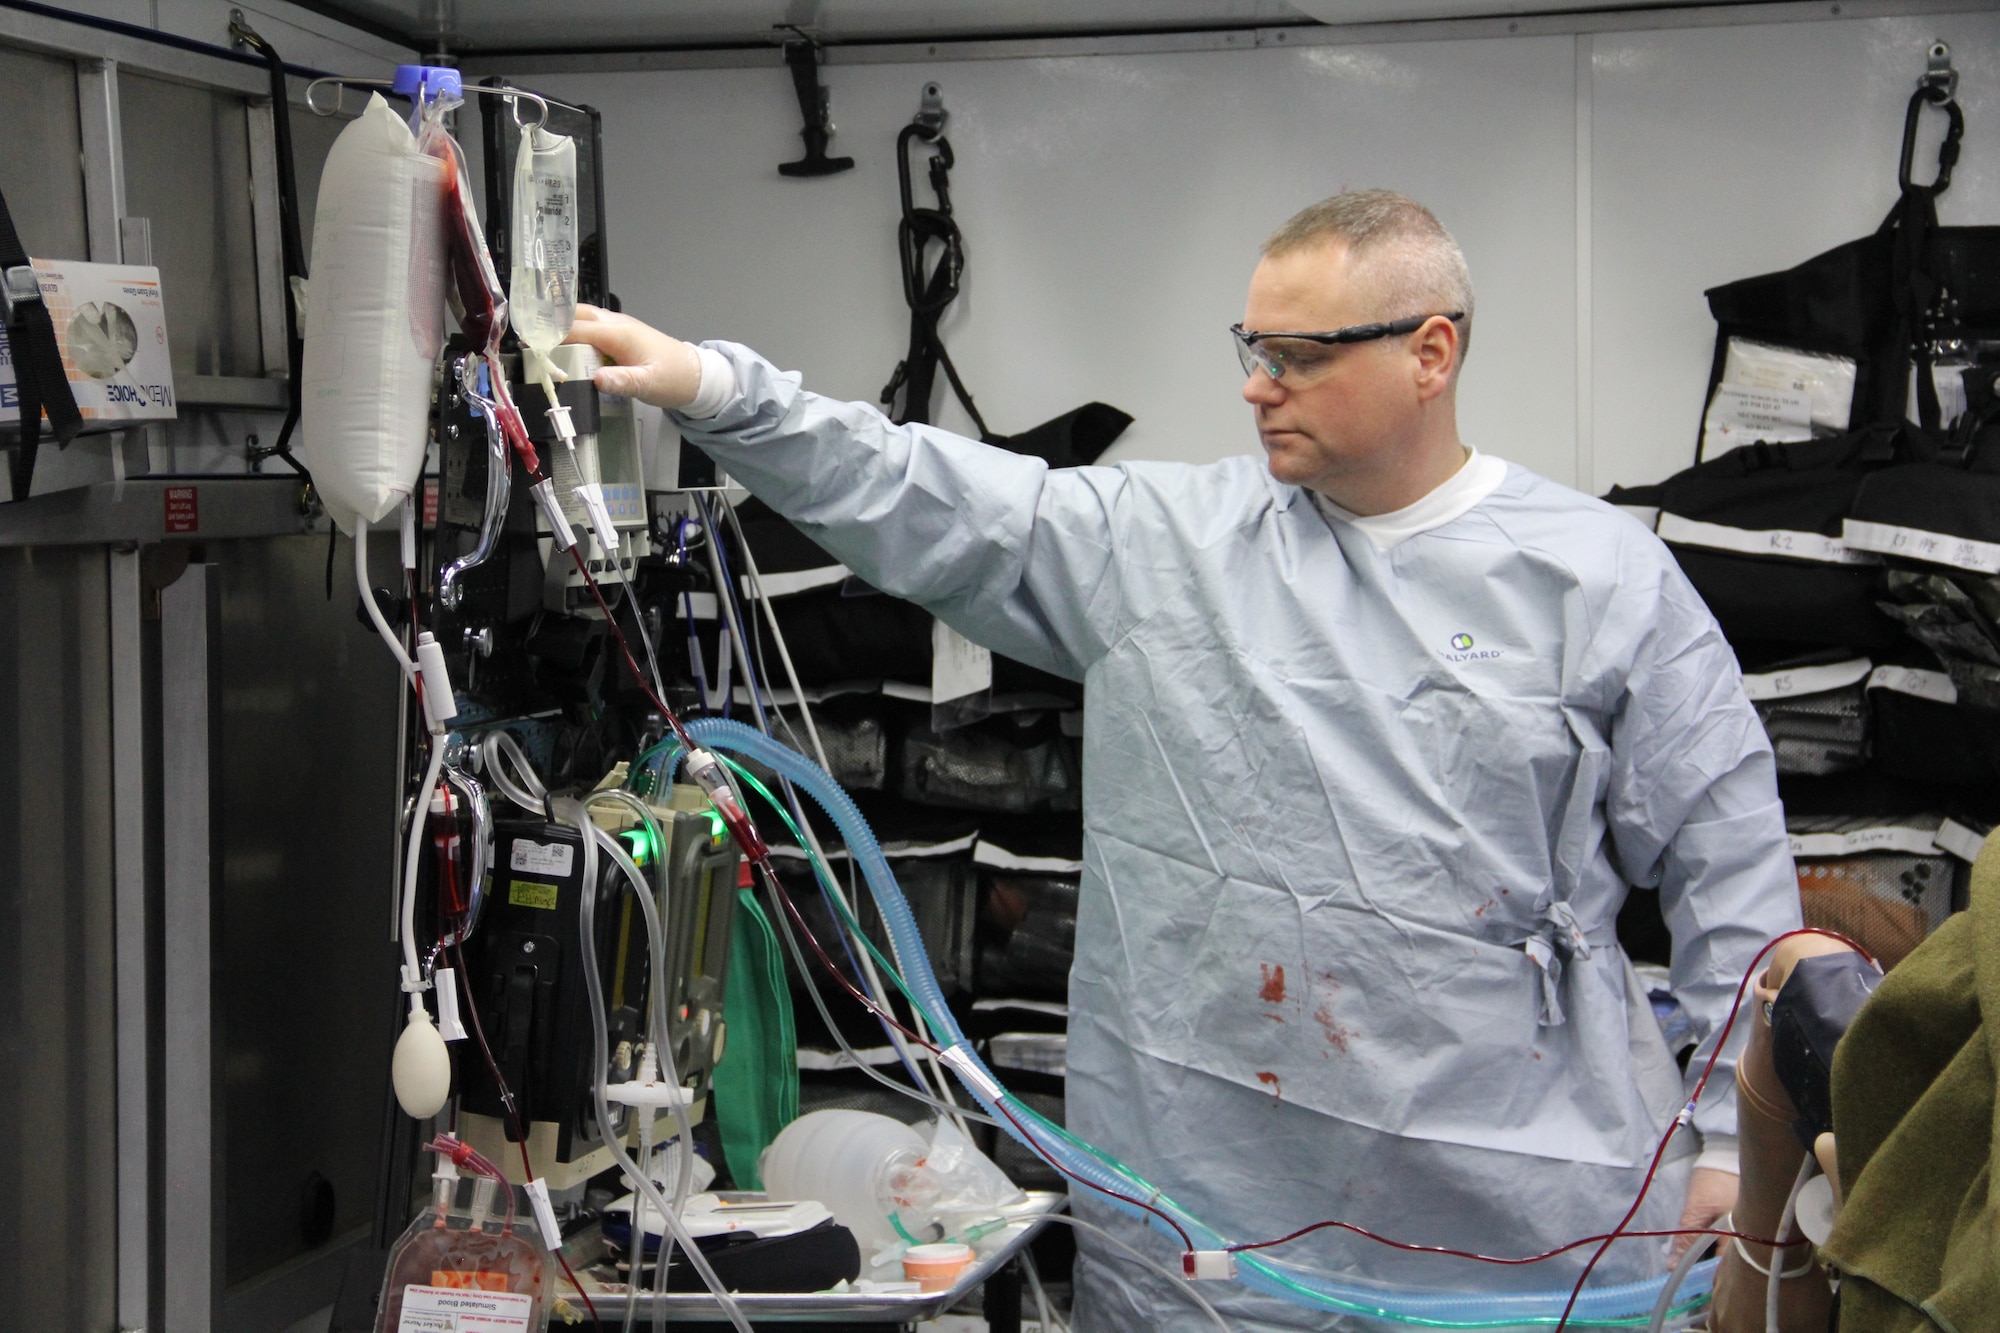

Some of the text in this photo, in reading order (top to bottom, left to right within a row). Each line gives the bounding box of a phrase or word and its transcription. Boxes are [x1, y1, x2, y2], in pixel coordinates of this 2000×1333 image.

[122, 287, 137, 297] Gloves
[169, 489, 193, 499] WARNING
[1770, 534, 1793, 550] R2
[437, 1299, 497, 1311] Simulated Blood
